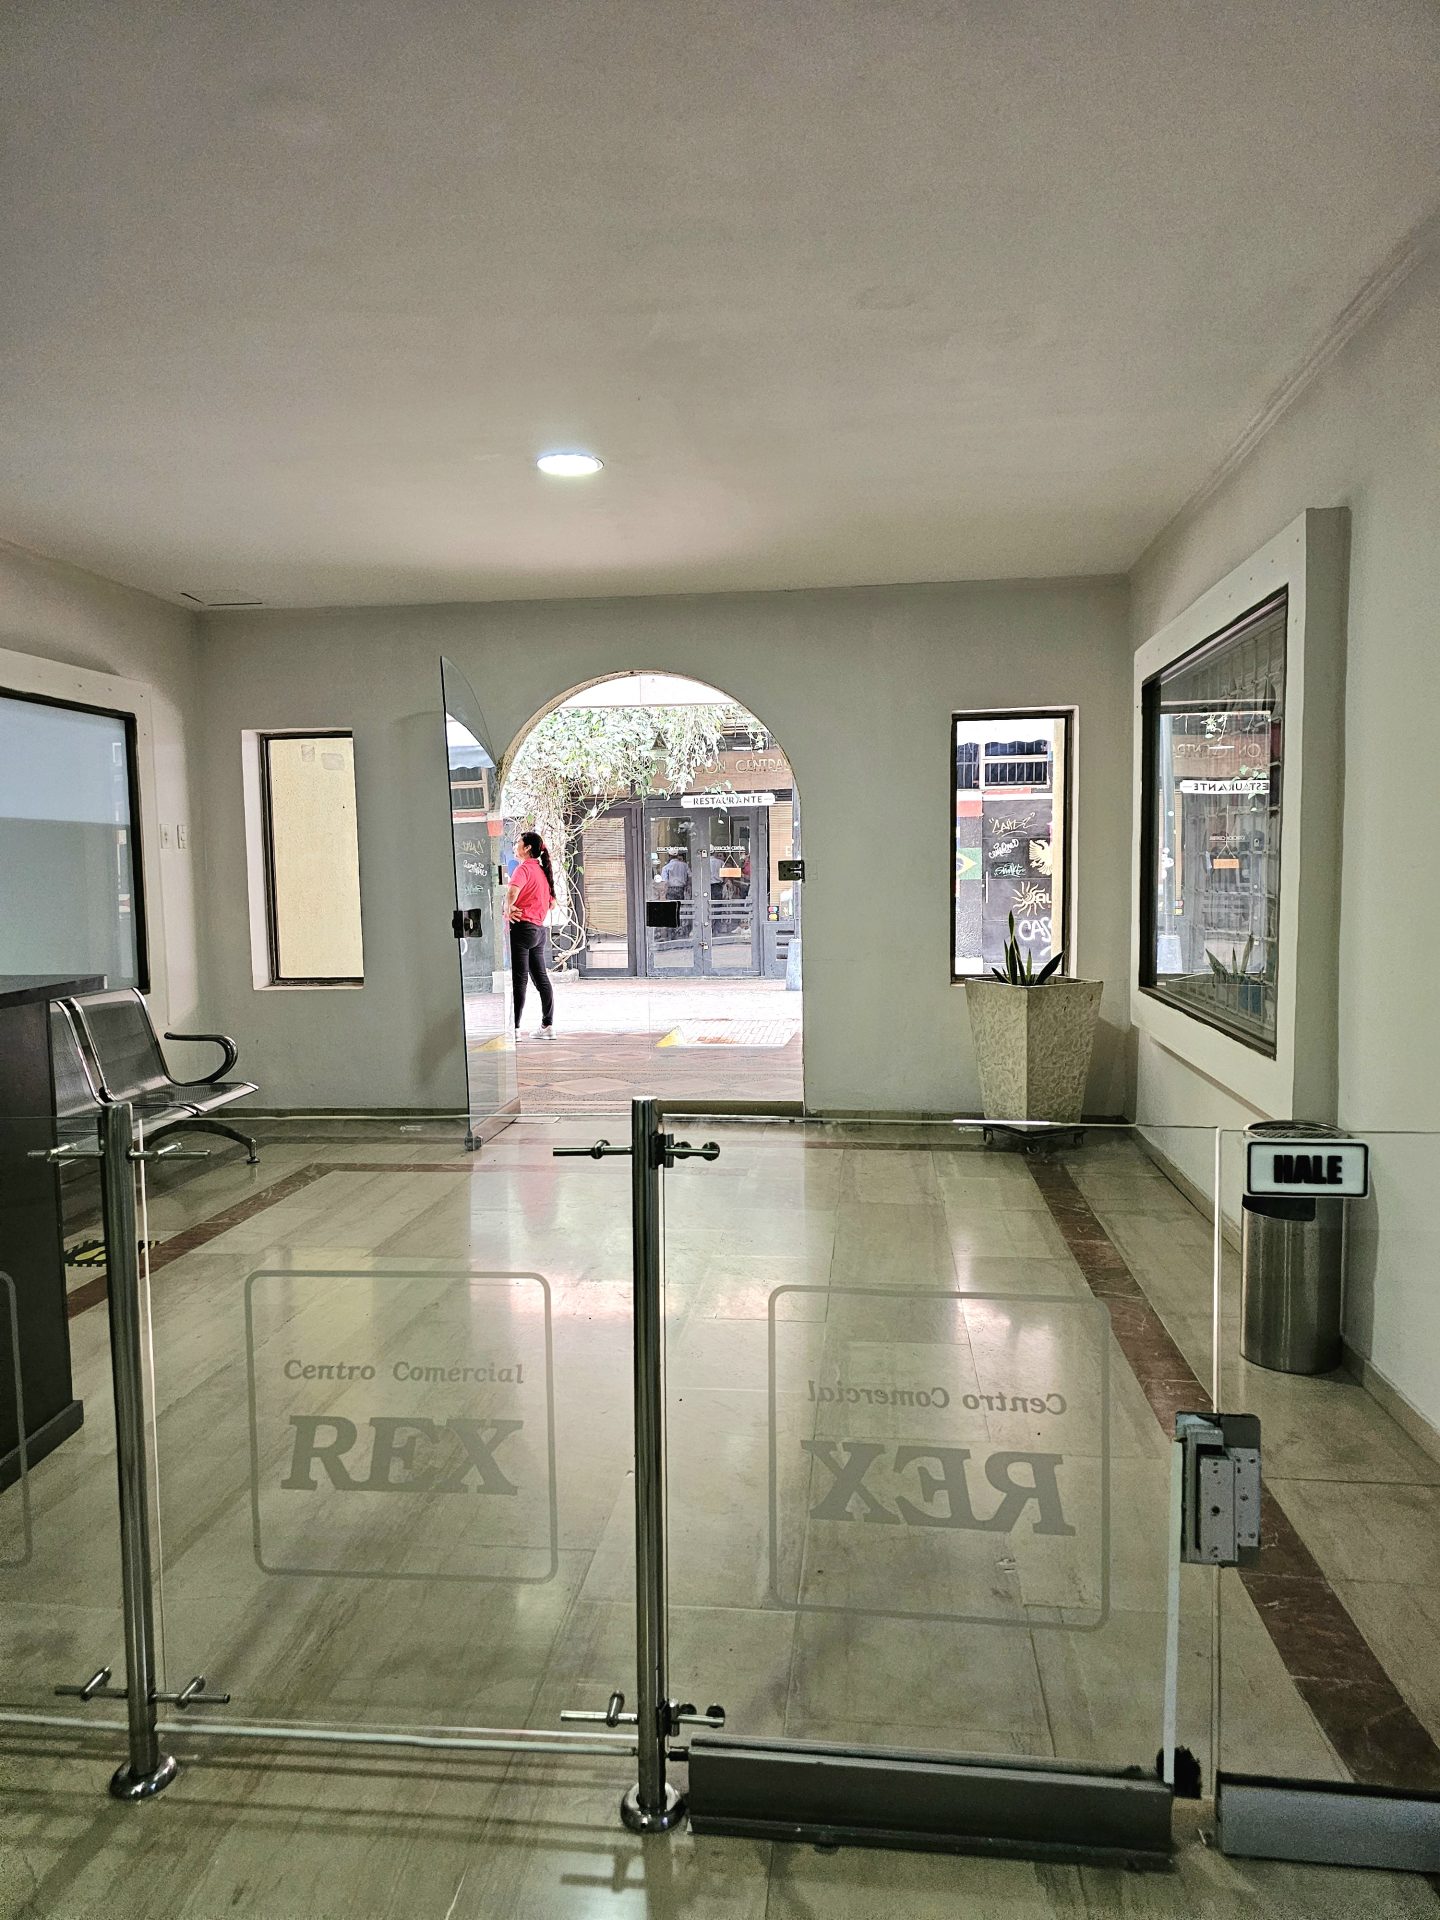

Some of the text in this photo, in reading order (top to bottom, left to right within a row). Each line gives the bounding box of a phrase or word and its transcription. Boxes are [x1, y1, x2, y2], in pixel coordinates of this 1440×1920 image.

[693, 796, 763, 806] RESTAURANTE
[1274, 1154, 1343, 1185] HALE
[283, 1359, 525, 1385] Centro Comercial
[280, 1415, 525, 1497] REX
